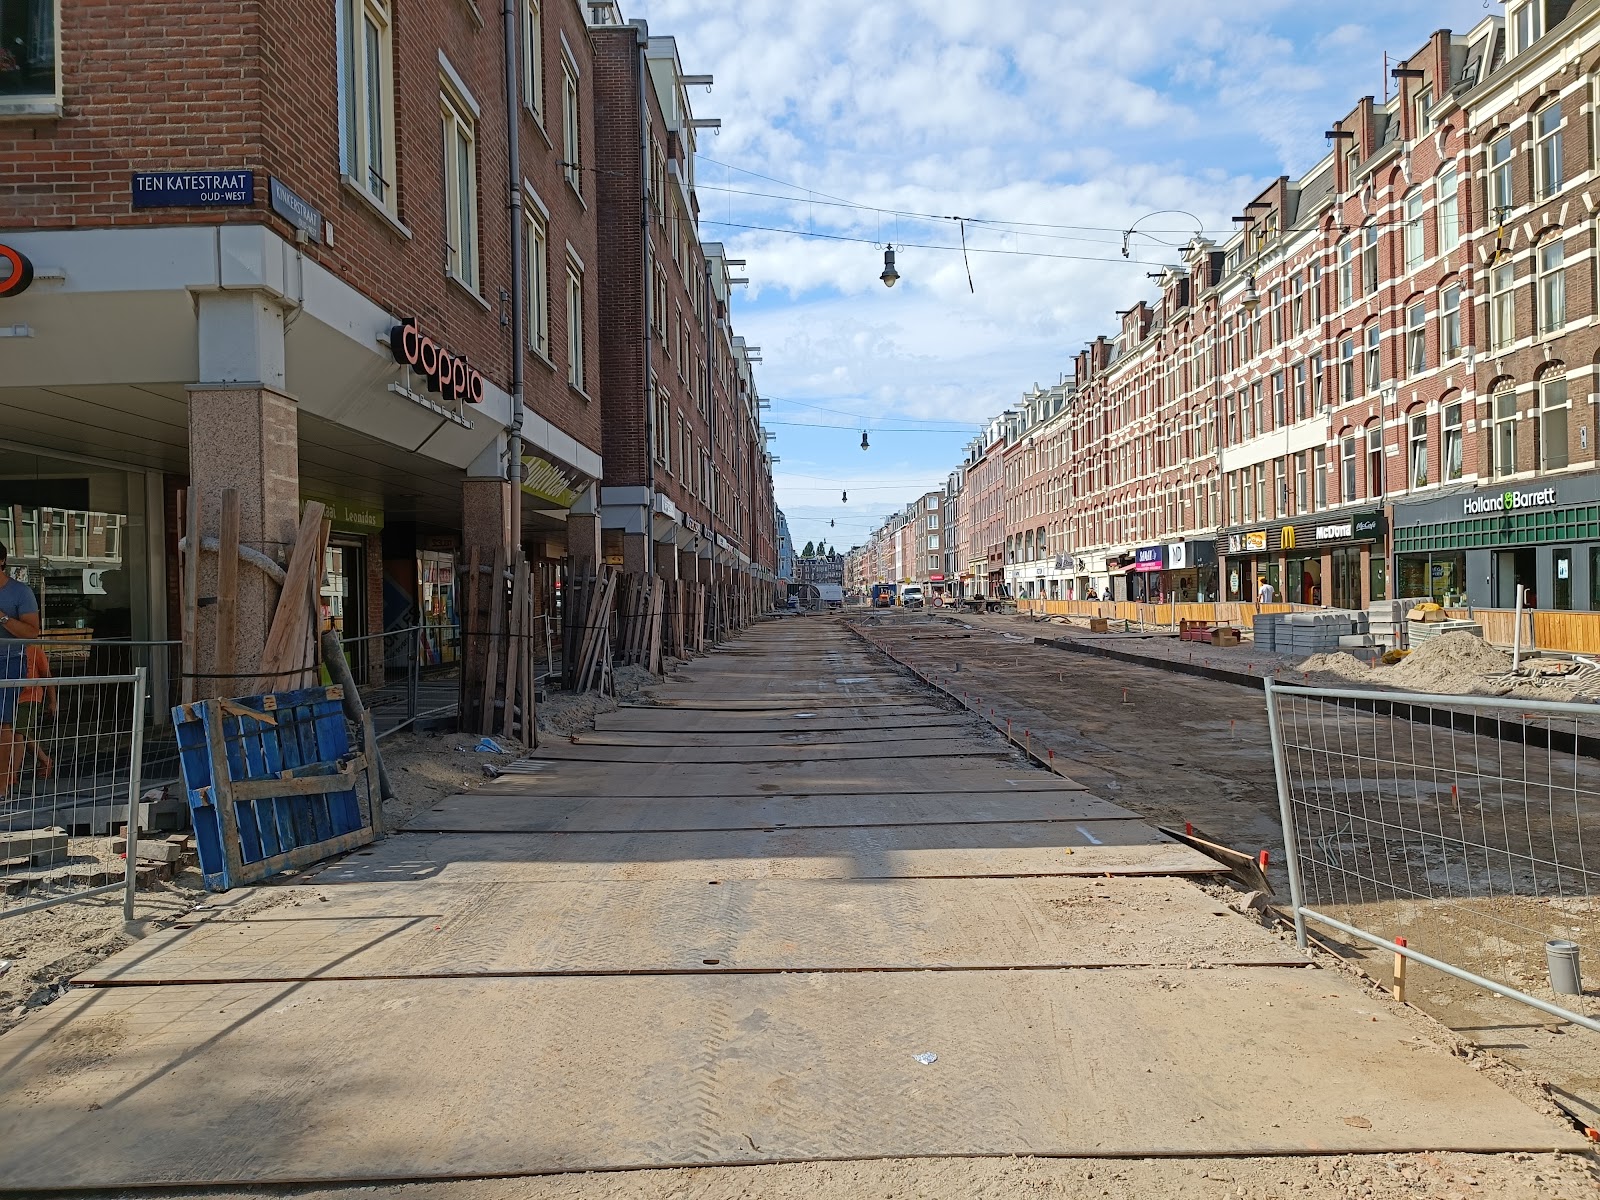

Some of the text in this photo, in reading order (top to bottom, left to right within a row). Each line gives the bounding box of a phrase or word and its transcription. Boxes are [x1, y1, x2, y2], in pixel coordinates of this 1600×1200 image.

[136, 175, 246, 191] TEN KATESTRAAT
[200, 191, 246, 202] OUD-WEST
[276, 185, 317, 227] KINKERSTRAAT
[401, 317, 484, 403] doppio
[1463, 493, 1504, 514] Holland
[1512, 487, 1556, 508] Barrett
[344, 507, 376, 526] Leonidas
